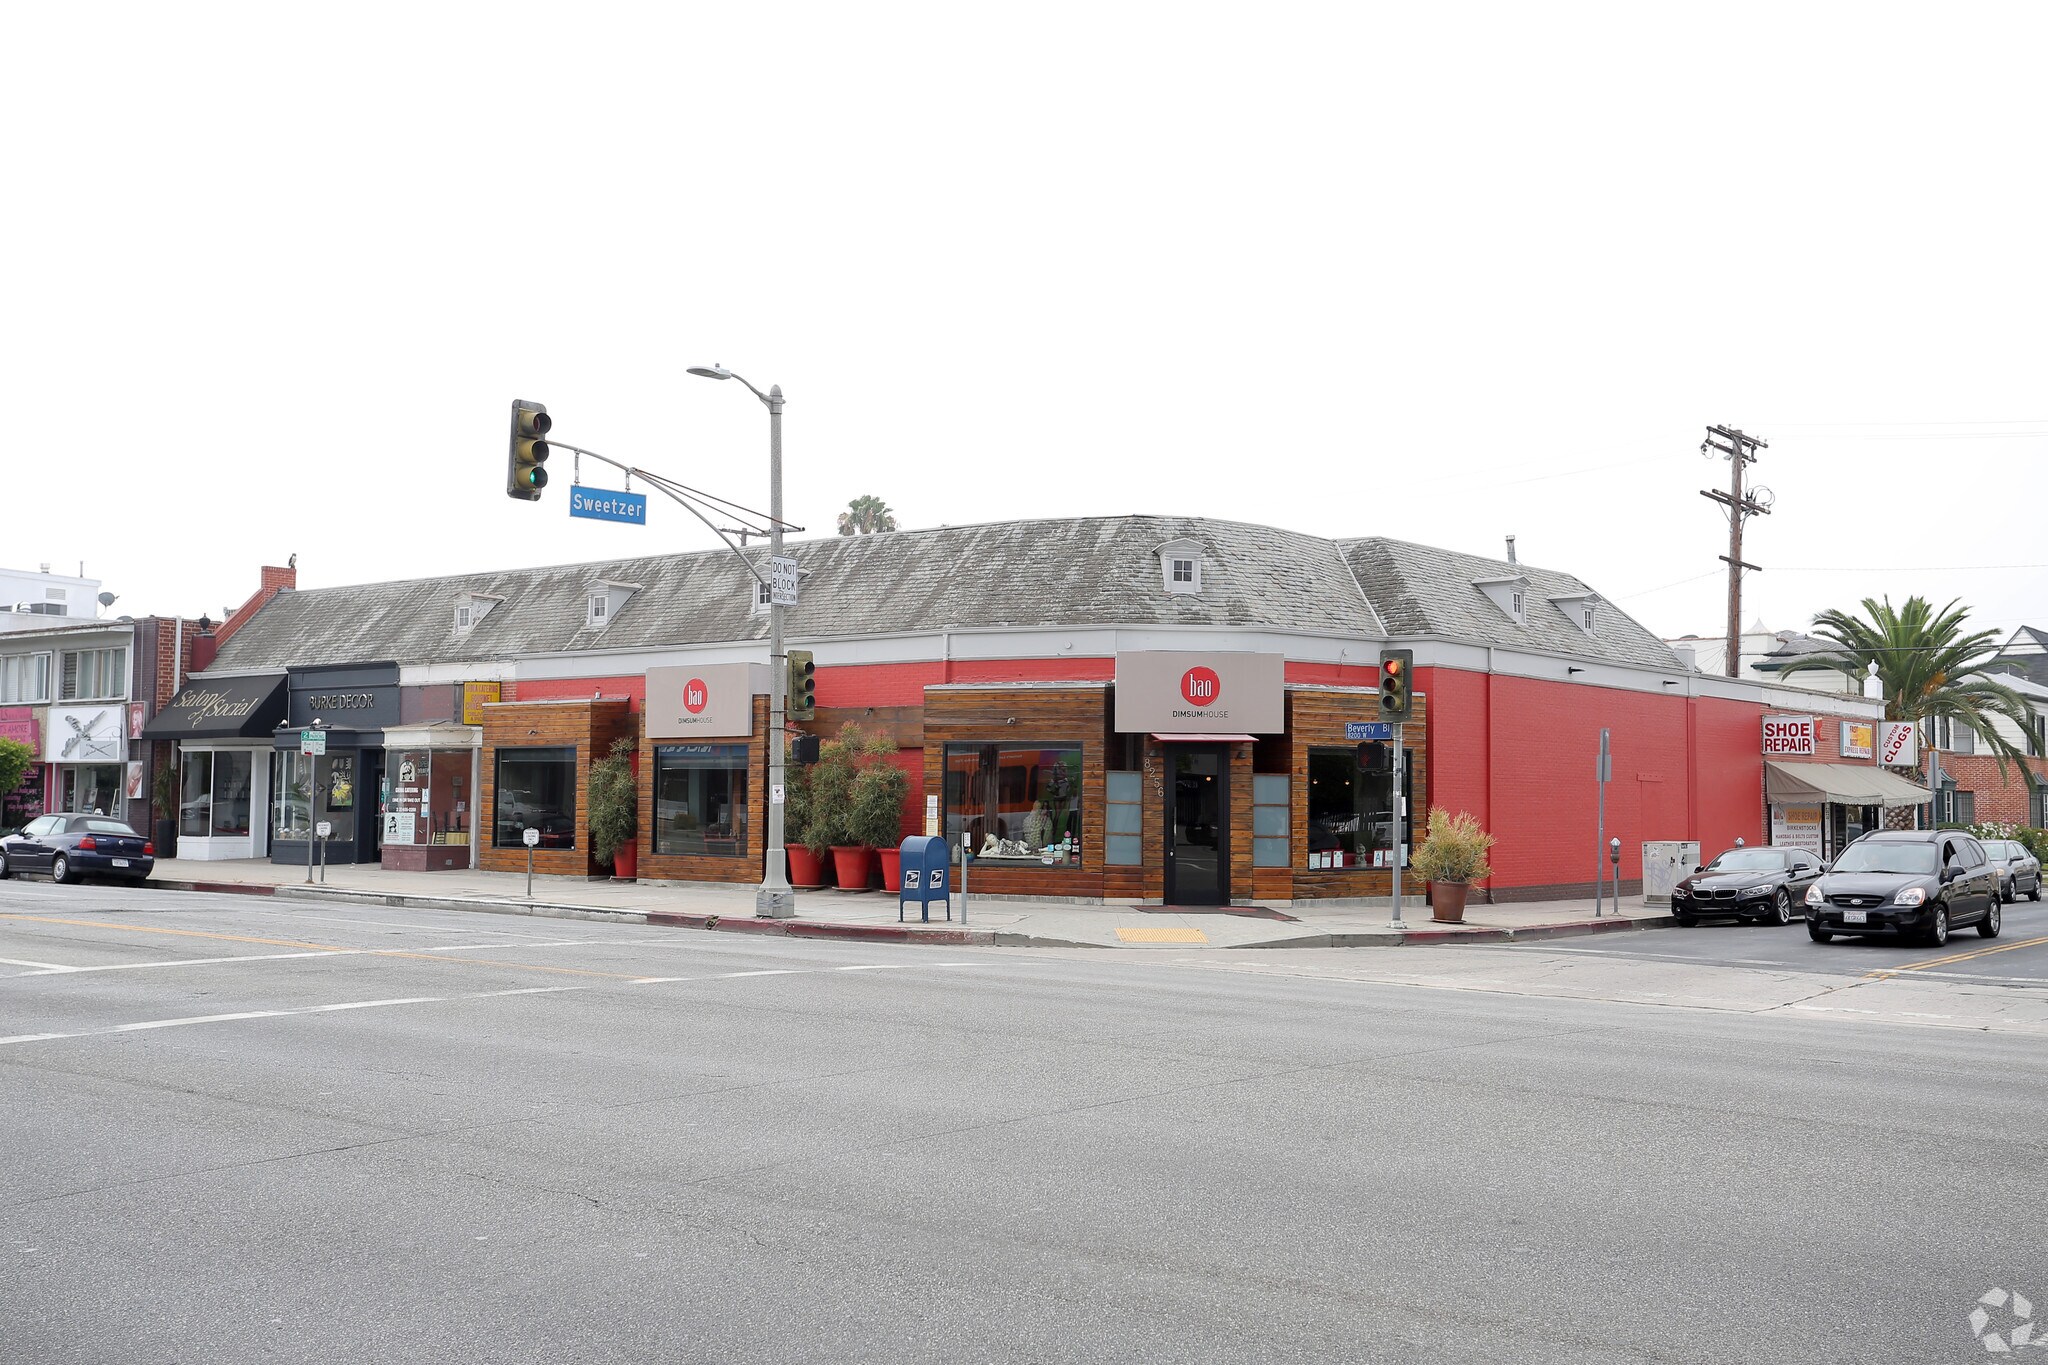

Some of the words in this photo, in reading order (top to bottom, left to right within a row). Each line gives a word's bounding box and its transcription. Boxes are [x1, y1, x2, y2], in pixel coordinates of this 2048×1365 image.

[573, 493, 643, 518] Sweetzer
[773, 562, 781, 573] DO
[784, 564, 795, 575] NOT
[773, 578, 795, 591] BLOCK
[478, 684, 499, 693] CATERING
[1189, 673, 1212, 697] bao
[309, 695, 338, 710] BURKE
[339, 693, 375, 709] DECOR
[687, 684, 703, 706] bao
[172, 690, 218, 708] Salon
[205, 697, 260, 718] Social
[1172, 710, 1229, 719] DIMSUMHOUSE
[303, 731, 309, 739] 2
[1348, 724, 1375, 734] Beverly
[1382, 724, 1390, 732] Bl
[1764, 722, 1810, 738] SHOE
[1883, 724, 1900, 748] CUSTOM
[1764, 737, 1811, 752] REPAIR
[1844, 745, 1858, 754] EXPRESS
[1859, 747, 1871, 755] REPAIR
[1884, 724, 1912, 763] CLOGS
[1143, 758, 1164, 797] 8256
[1788, 811, 1800, 821] SHOE
[1801, 811, 1818, 821] REPAIR
[1375, 853, 1381, 862] A
